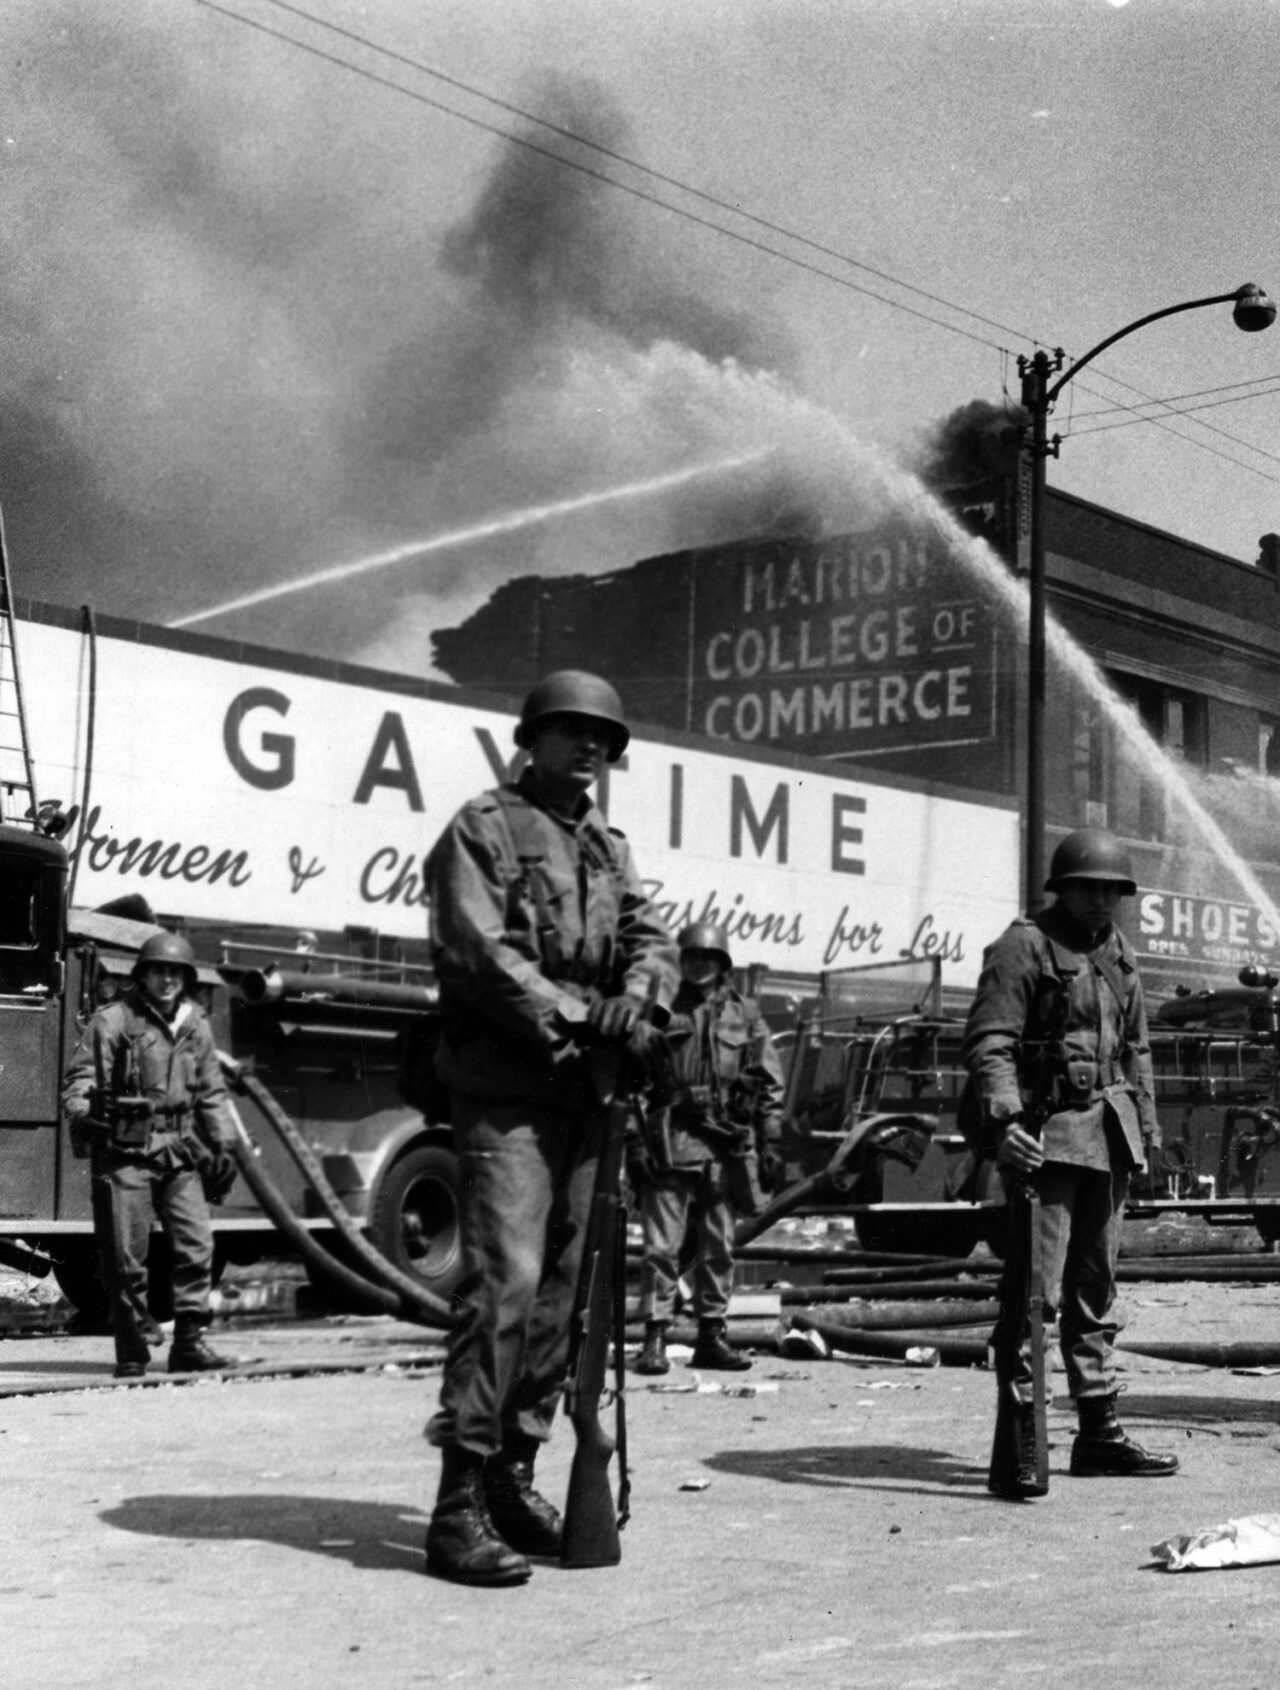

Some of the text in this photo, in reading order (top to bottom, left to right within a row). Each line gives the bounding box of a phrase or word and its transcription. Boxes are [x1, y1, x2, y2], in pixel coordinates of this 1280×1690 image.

[706, 606, 976, 680] COLLEGE OF
[705, 666, 972, 741] COMMERCE
[288, 845, 326, 894] &
[822, 904, 883, 966] for
[900, 914, 966, 963] Less
[1139, 894, 1277, 948] SHOES
